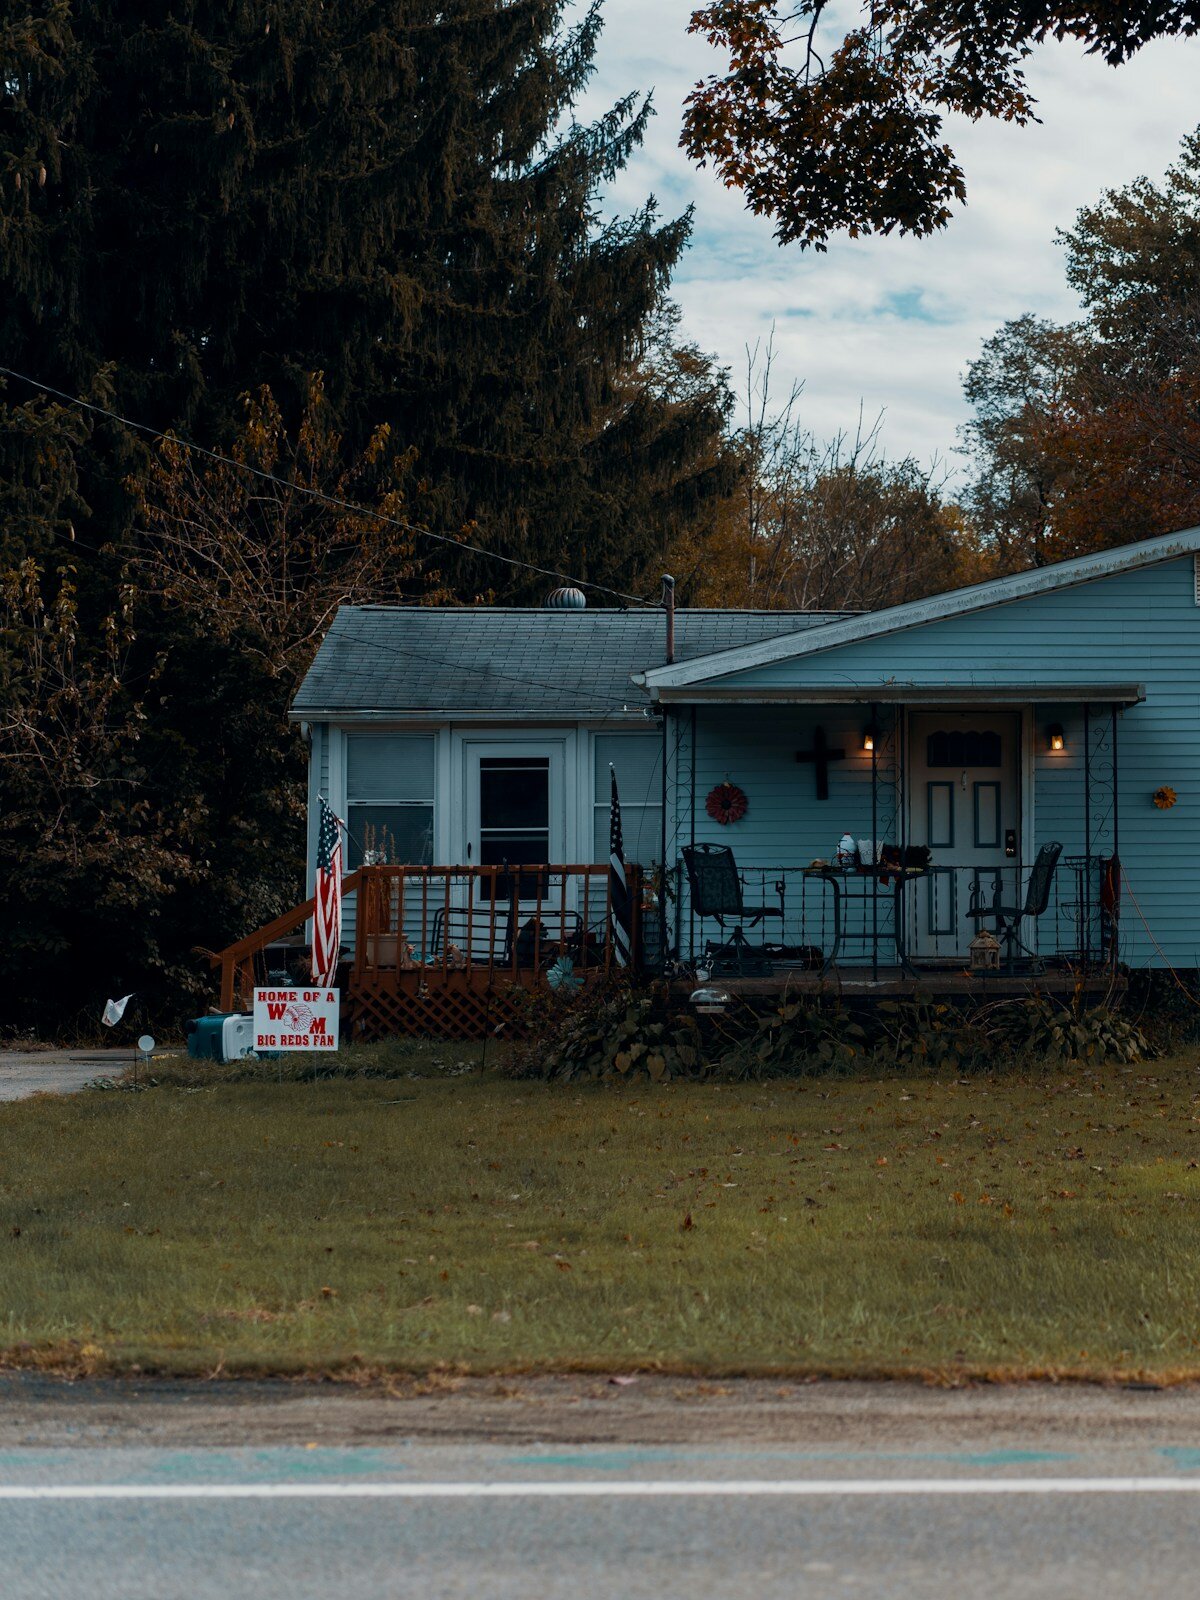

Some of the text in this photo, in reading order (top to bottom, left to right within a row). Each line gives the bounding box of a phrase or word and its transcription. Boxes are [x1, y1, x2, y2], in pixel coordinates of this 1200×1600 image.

[258, 991, 336, 1002] HOME OF A
[267, 1003, 326, 1034] W M
[257, 1035, 334, 1046] BIG REDS FAN
